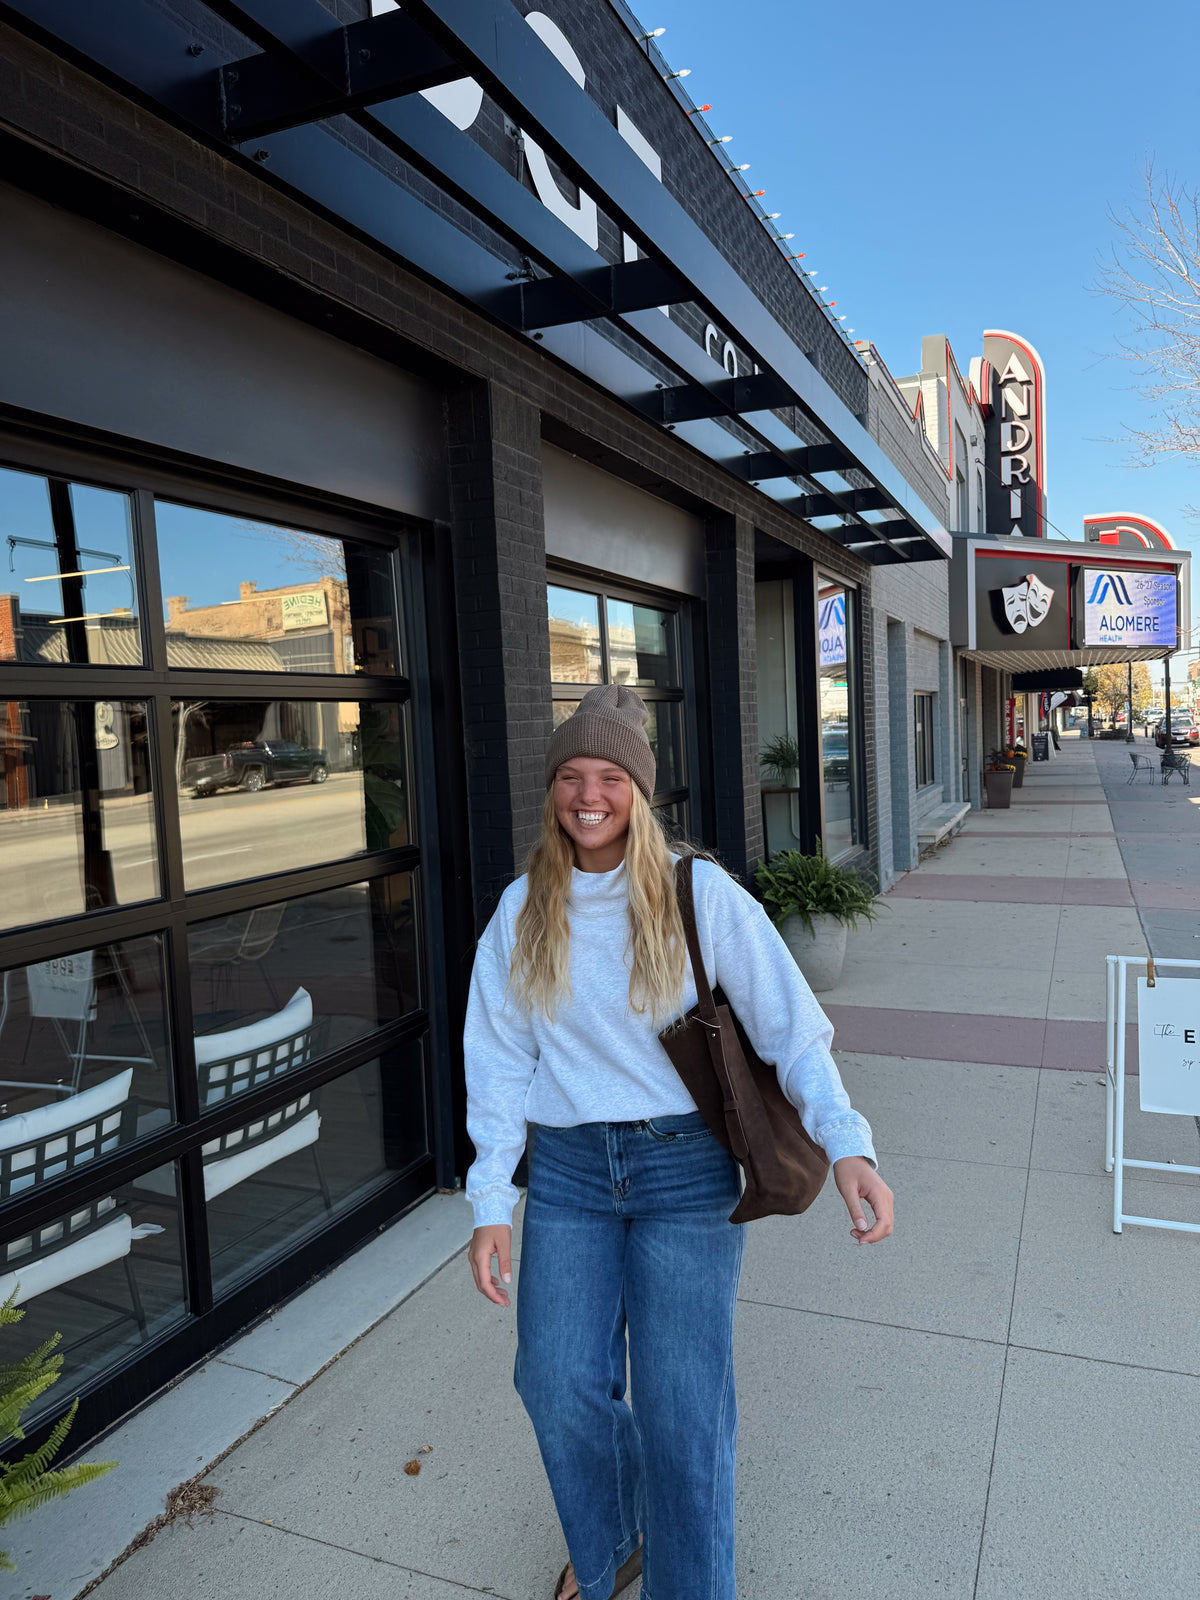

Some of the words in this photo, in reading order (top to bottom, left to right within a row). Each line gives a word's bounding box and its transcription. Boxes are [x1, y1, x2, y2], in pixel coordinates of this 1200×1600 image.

[1153, 582, 1173, 592] Season
[1143, 595, 1166, 607] Sponsor
[1099, 614, 1160, 632] ALOMERE
[1099, 633, 1123, 642] HEALTH
